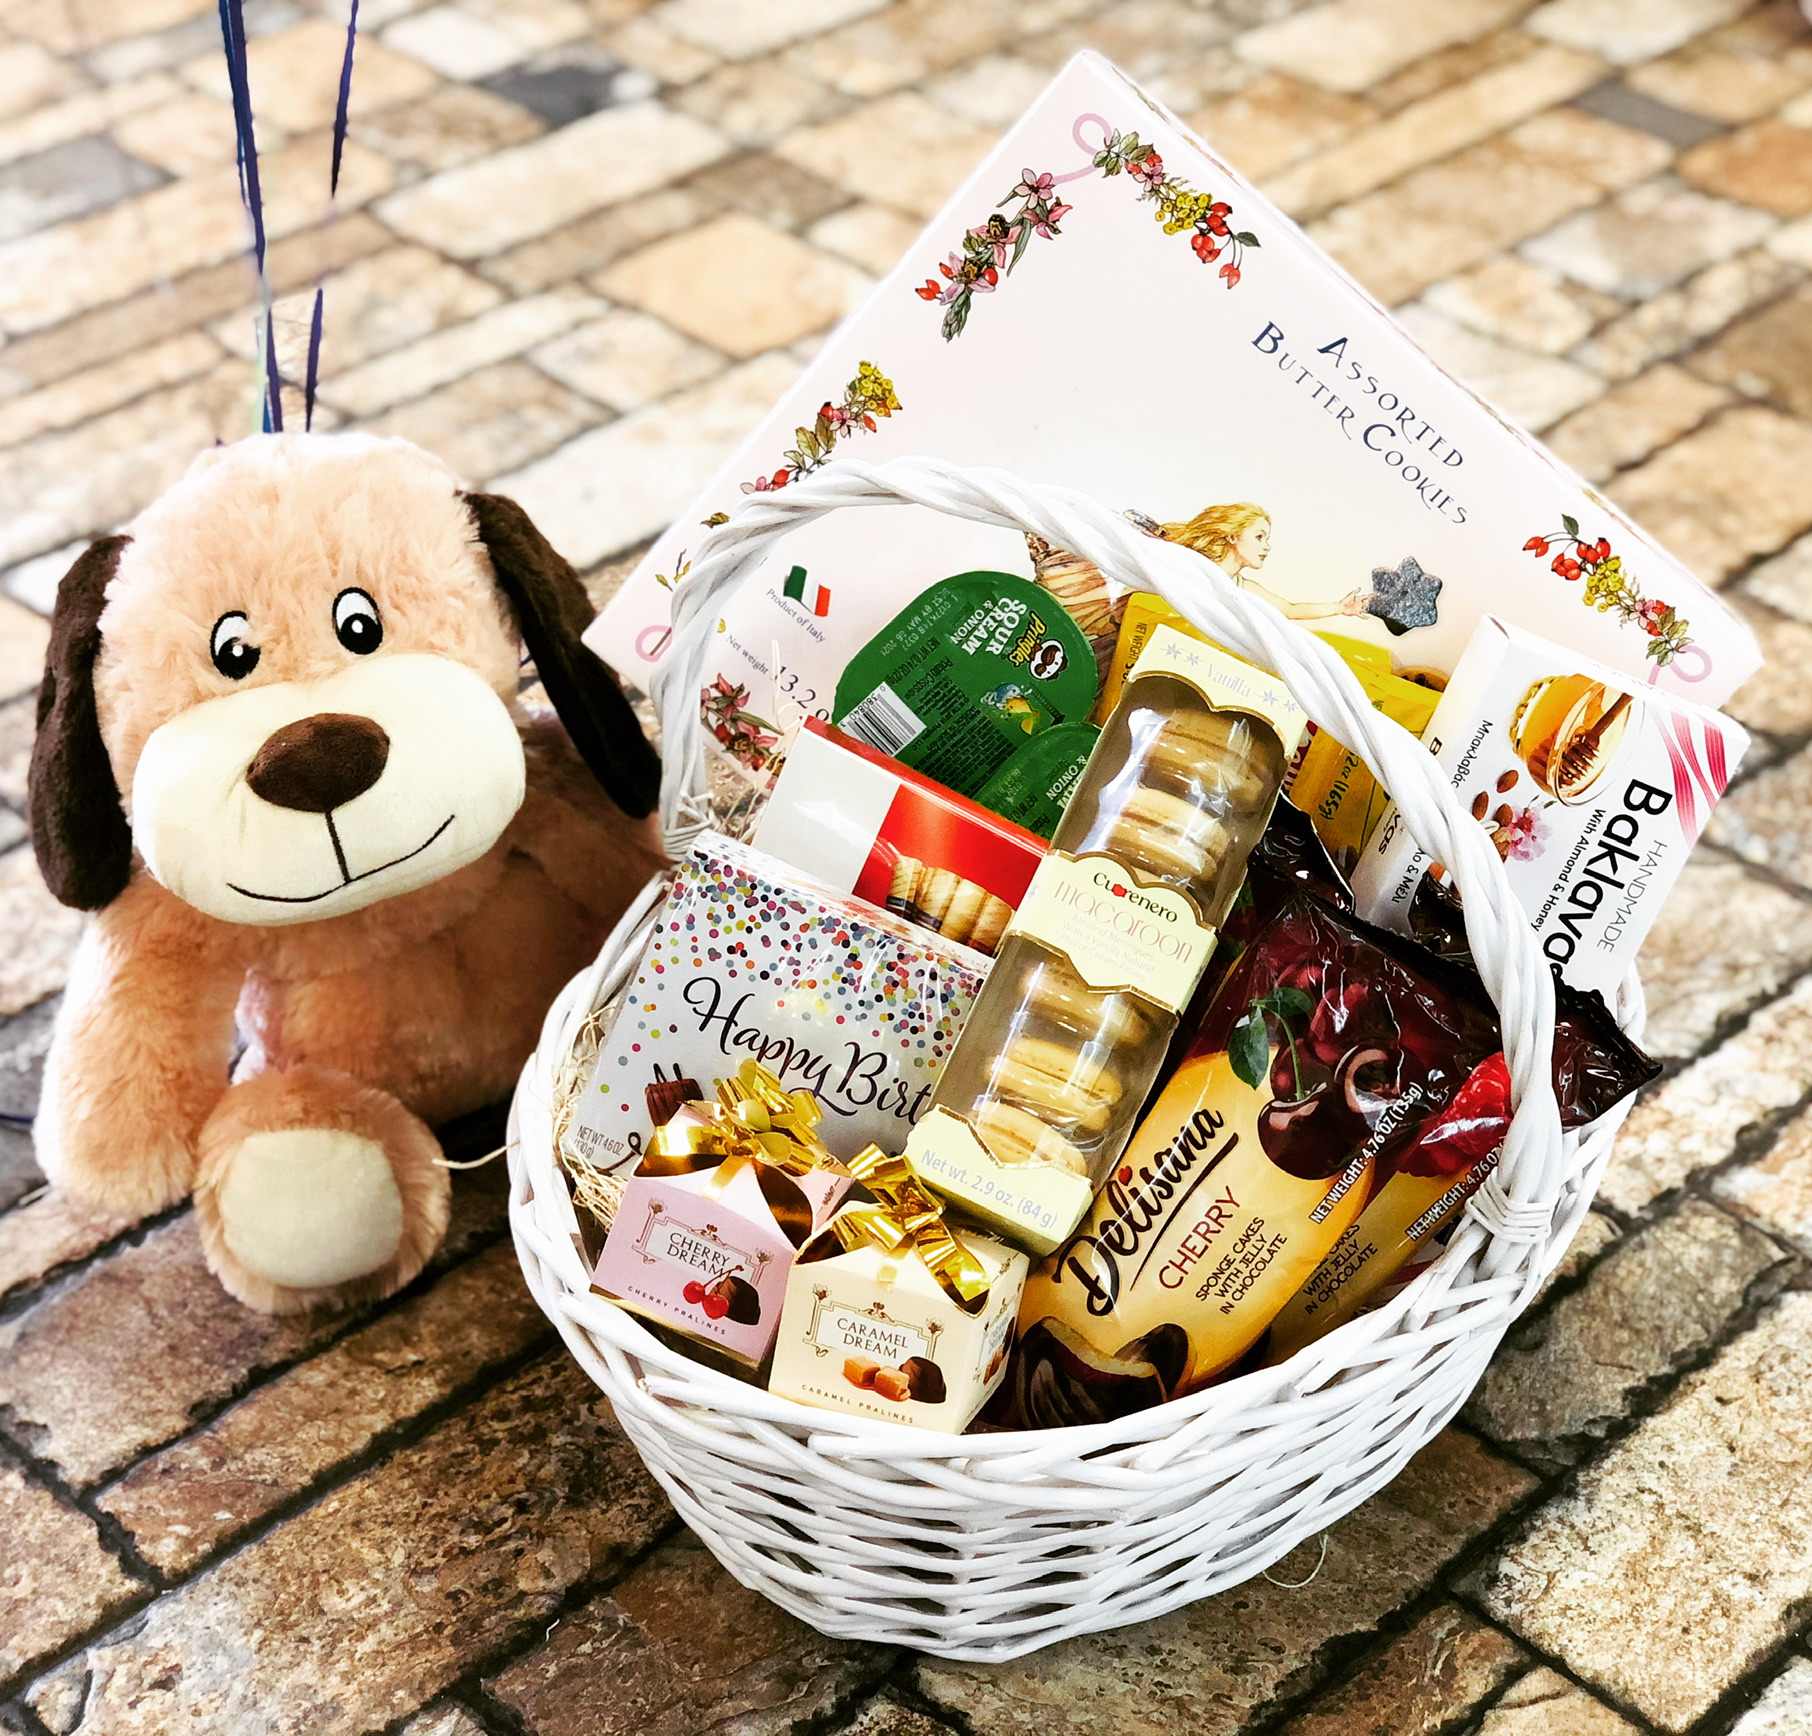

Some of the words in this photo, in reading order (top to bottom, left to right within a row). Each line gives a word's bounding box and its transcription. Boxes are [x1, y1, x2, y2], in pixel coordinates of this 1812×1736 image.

[1251, 321, 1355, 441] BUTTER
[1363, 424, 1467, 524] COOKIES
[1317, 336, 1463, 467] ASSORTED
[766, 588, 797, 619] Product
[797, 615, 810, 629] of
[808, 620, 826, 643] Italy
[951, 608, 985, 645] ONION
[962, 597, 1010, 656] CREAM
[983, 600, 993, 610] &
[986, 599, 1027, 655] SOUR
[728, 635, 742, 652] Net
[742, 649, 769, 675] weight
[1009, 613, 1046, 667] Pringles
[1207, 663, 1250, 698] Vanilla
[1046, 765, 1079, 800] ONION
[1317, 780, 1350, 820] (165g)
[1586, 808, 1606, 836] With
[1559, 836, 1587, 883] Almond
[1532, 893, 1560, 932] Honey
[1556, 883, 1566, 894] &
[1598, 840, 1668, 952] HANDMADE
[1053, 881, 1193, 963] macaroon
[683, 977, 857, 1117] Happy
[836, 1041, 933, 1126] Birt
[1309, 1201, 1333, 1223] NET
[1330, 1157, 1369, 1204] WEIGHT:
[1362, 1131, 1386, 1160] 4.76
[1380, 1117, 1397, 1134] OZ
[1391, 1081, 1425, 1121] (135g)
[921, 1150, 947, 1173] Net
[948, 1166, 968, 1185] wt.
[971, 1175, 994, 1194] 2.9
[996, 1189, 1013, 1207] oz.
[1017, 1199, 1041, 1218] (84
[1042, 1212, 1058, 1228] g)
[1053, 1103, 1225, 1317] Delisana
[1405, 1217, 1430, 1240] NET
[1427, 1184, 1470, 1223] WEIGHT:
[1467, 1161, 1490, 1186] 4.76
[667, 1244, 725, 1279] DREAM
[670, 1232, 731, 1267] CHERRY
[1159, 1185, 1240, 1290] CHERRY
[1195, 1254, 1236, 1302] SPONGE
[1232, 1217, 1265, 1254] CAKES
[1214, 1267, 1244, 1298] WITH
[1239, 1233, 1267, 1269] JELLY
[1219, 1301, 1235, 1315] IN
[1231, 1233, 1288, 1301] CHOCOLATE
[1303, 1268, 1332, 1297] WITH
[1331, 1239, 1359, 1271] JELLY
[1304, 1300, 1319, 1315] IN
[1318, 1242, 1378, 1303] CHOCOLATE
[627, 1285, 668, 1308] CHERRY
[673, 1307, 726, 1335] PRALINES
[837, 1318, 909, 1348] CARAMEL
[843, 1333, 898, 1360] DREAM
[801, 1384, 852, 1406] CARAMEL
[859, 1402, 914, 1424] PRALINES
